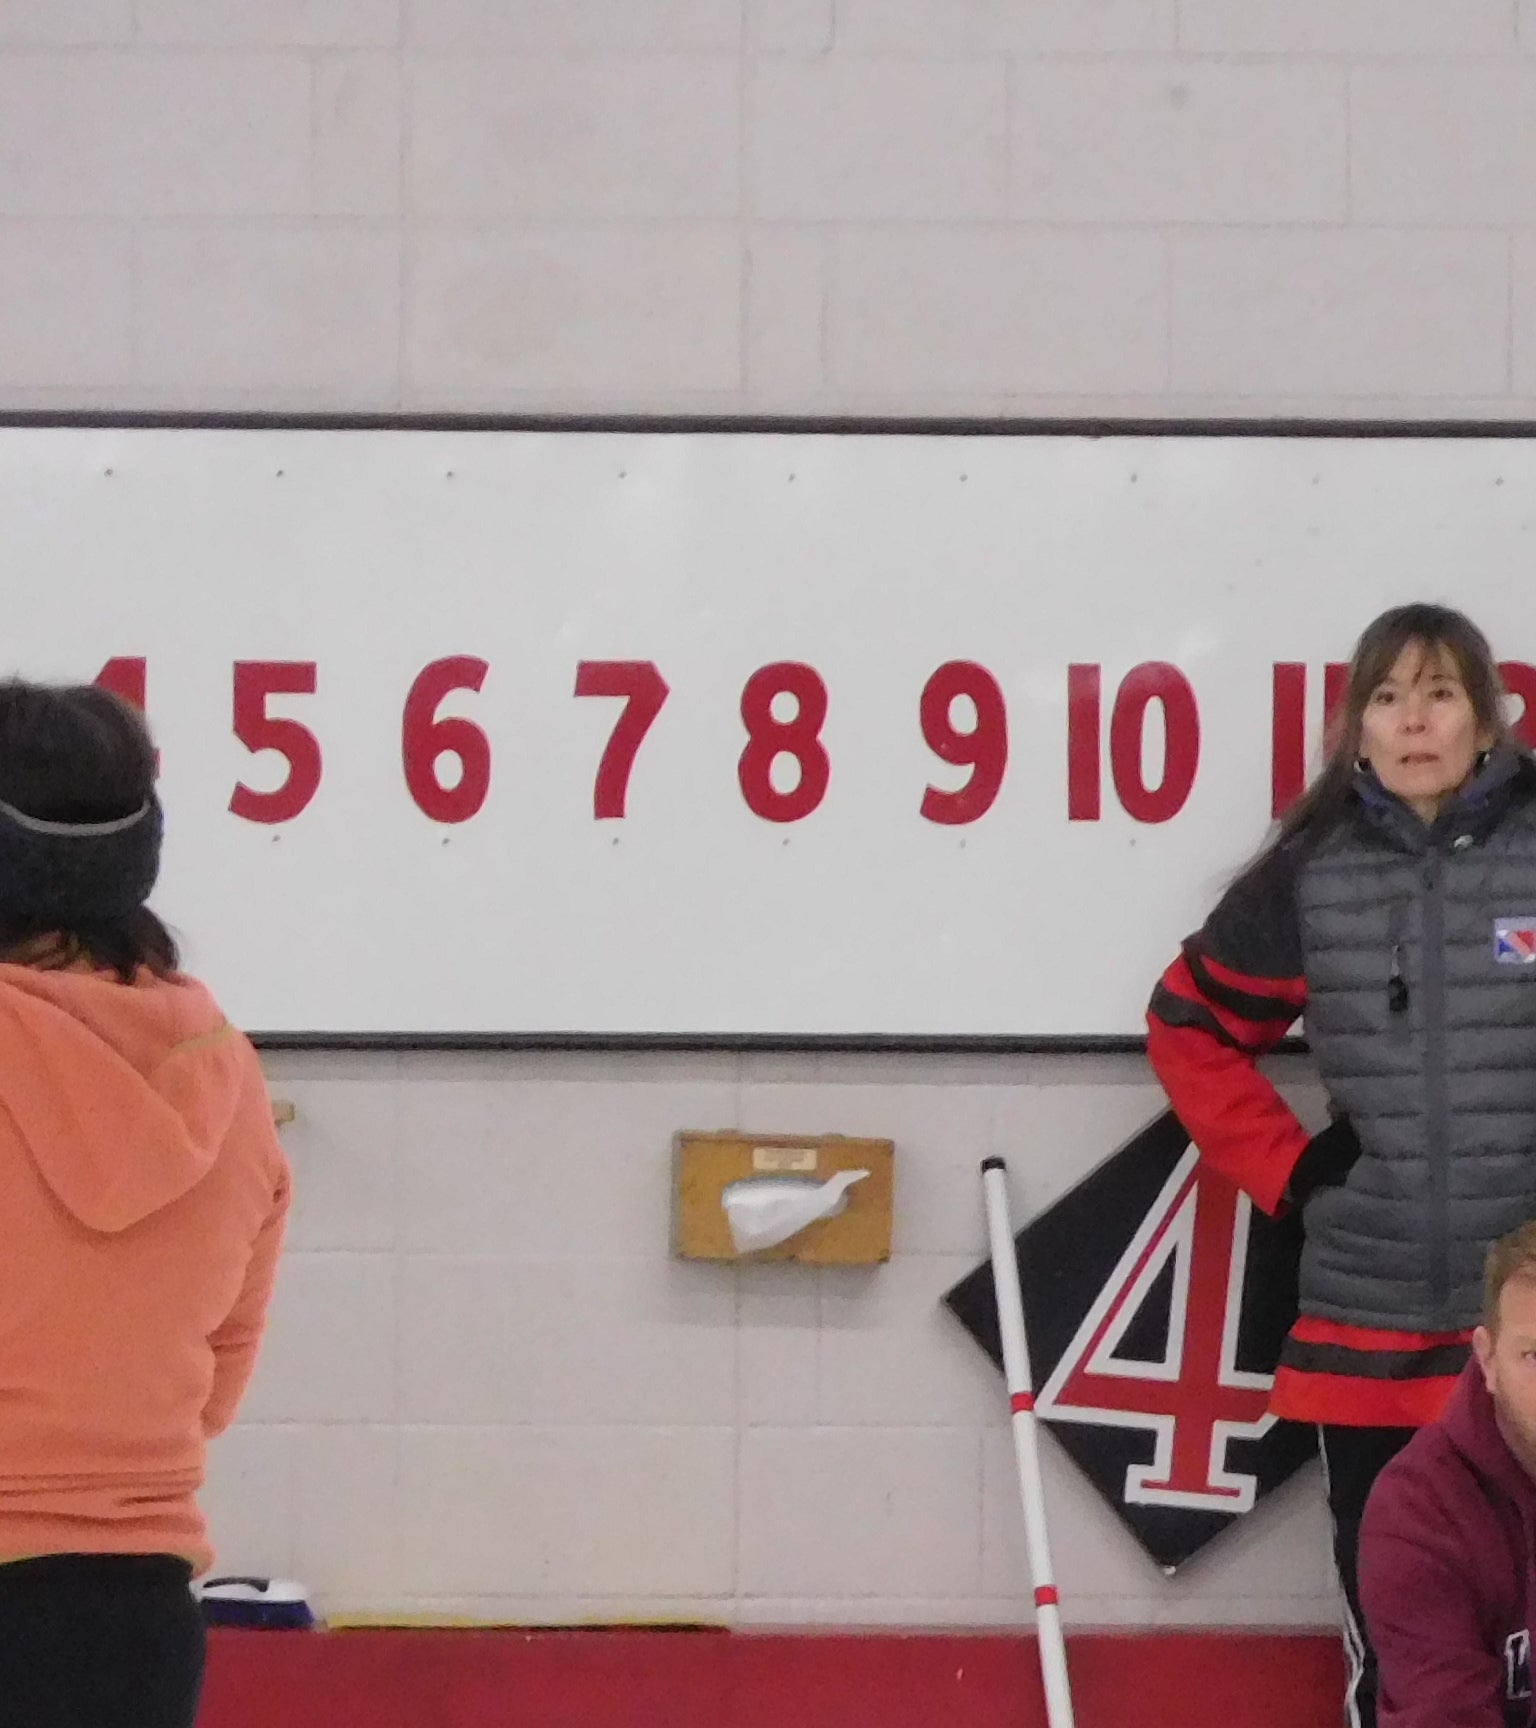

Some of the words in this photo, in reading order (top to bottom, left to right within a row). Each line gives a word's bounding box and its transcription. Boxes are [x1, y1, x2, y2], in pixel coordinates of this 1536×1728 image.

[230, 660, 321, 824] 5
[402, 656, 491, 824] 6
[574, 660, 669, 820] 7
[737, 661, 830, 823] 8
[919, 660, 1008, 825] 9
[1067, 662, 1200, 824] 10
[1032, 1140, 1281, 1513] 4
